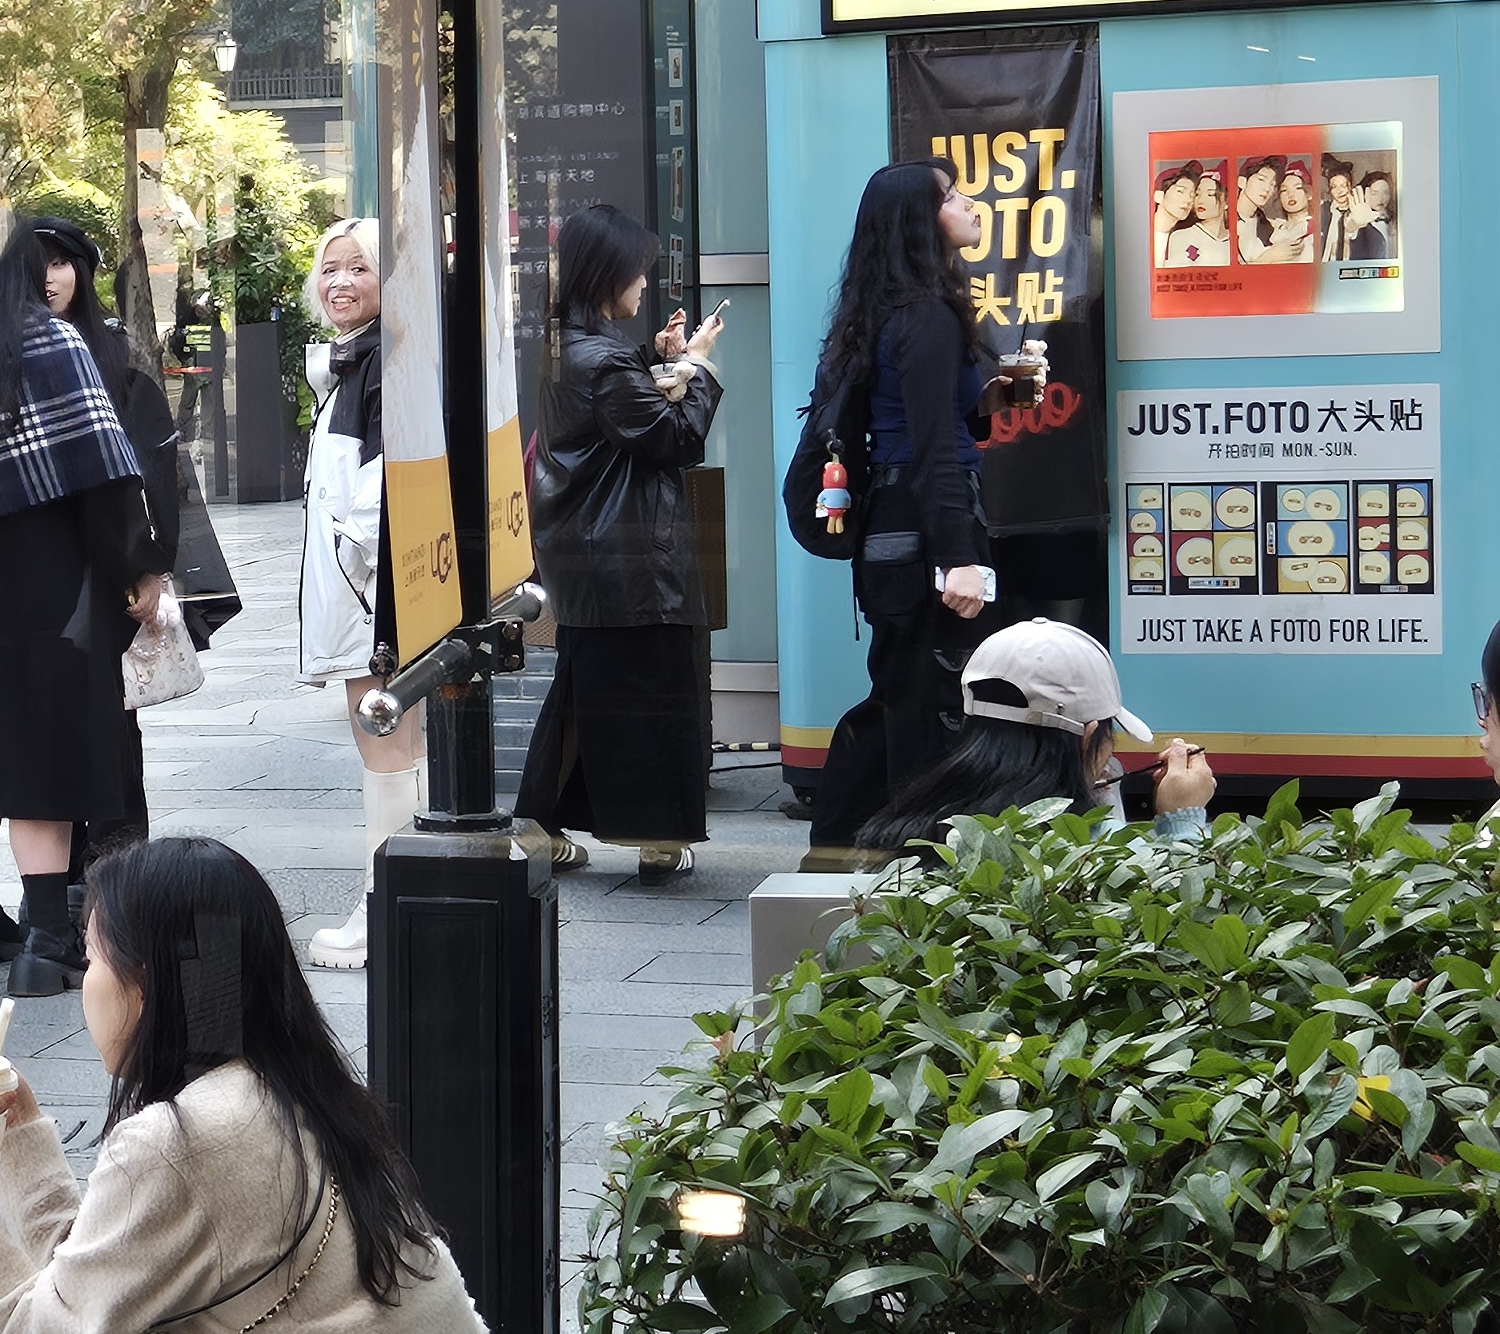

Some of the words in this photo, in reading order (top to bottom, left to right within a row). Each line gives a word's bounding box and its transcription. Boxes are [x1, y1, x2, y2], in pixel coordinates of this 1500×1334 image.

[958, 195, 1067, 263] OTO
[970, 269, 1065, 326] 头贴
[1316, 397, 1423, 434] 大头贴
[1207, 442, 1275, 460] 开拍时间
[1281, 441, 1358, 458] MON.-SUN.
[1136, 618, 1188, 644] JUST
[1192, 618, 1243, 644] TAKE
[1249, 618, 1264, 644] A
[1270, 618, 1322, 644] FOTO
[1329, 618, 1371, 644] FOR
[1378, 618, 1429, 644] LIFE.
